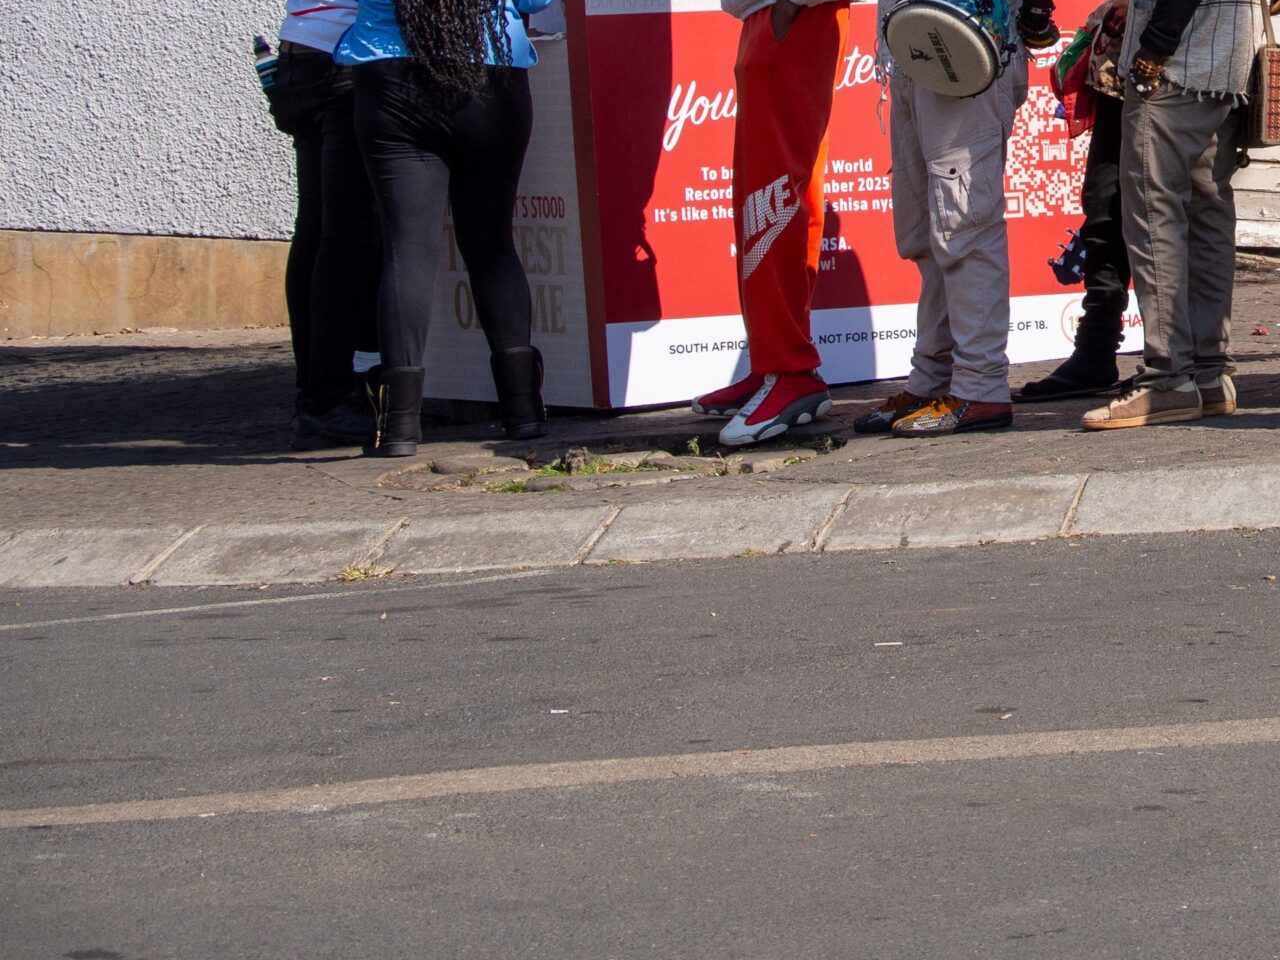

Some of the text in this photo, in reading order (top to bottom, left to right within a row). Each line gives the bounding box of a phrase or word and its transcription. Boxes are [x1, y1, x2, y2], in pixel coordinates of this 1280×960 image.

[701, 166, 717, 181] To
[832, 158, 873, 174] World
[530, 195, 566, 219] STOOD
[832, 197, 869, 213] shisa
[654, 208, 678, 223] It's
[681, 206, 708, 221] like
[1017, 321, 1031, 331] OF
[1035, 320, 1048, 330] 18.
[819, 333, 842, 345] NOT
[845, 331, 869, 343] FOR
[669, 342, 708, 355] SOUTH
